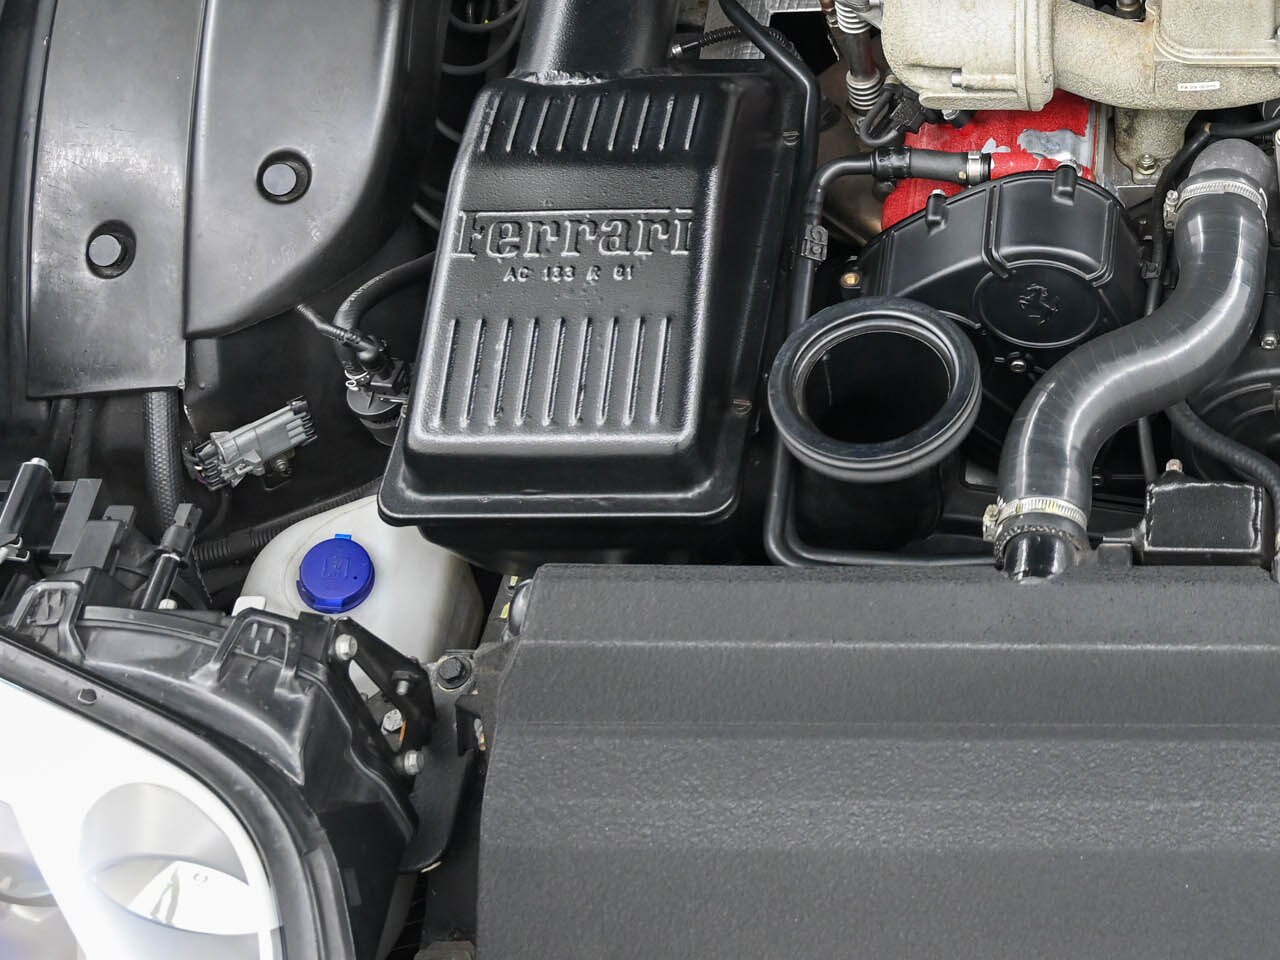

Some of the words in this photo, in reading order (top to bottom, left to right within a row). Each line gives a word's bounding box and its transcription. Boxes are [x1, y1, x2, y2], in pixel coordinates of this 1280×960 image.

[450, 208, 693, 259] Ferrari
[503, 266, 530, 282] AC
[542, 266, 575, 282] 133
